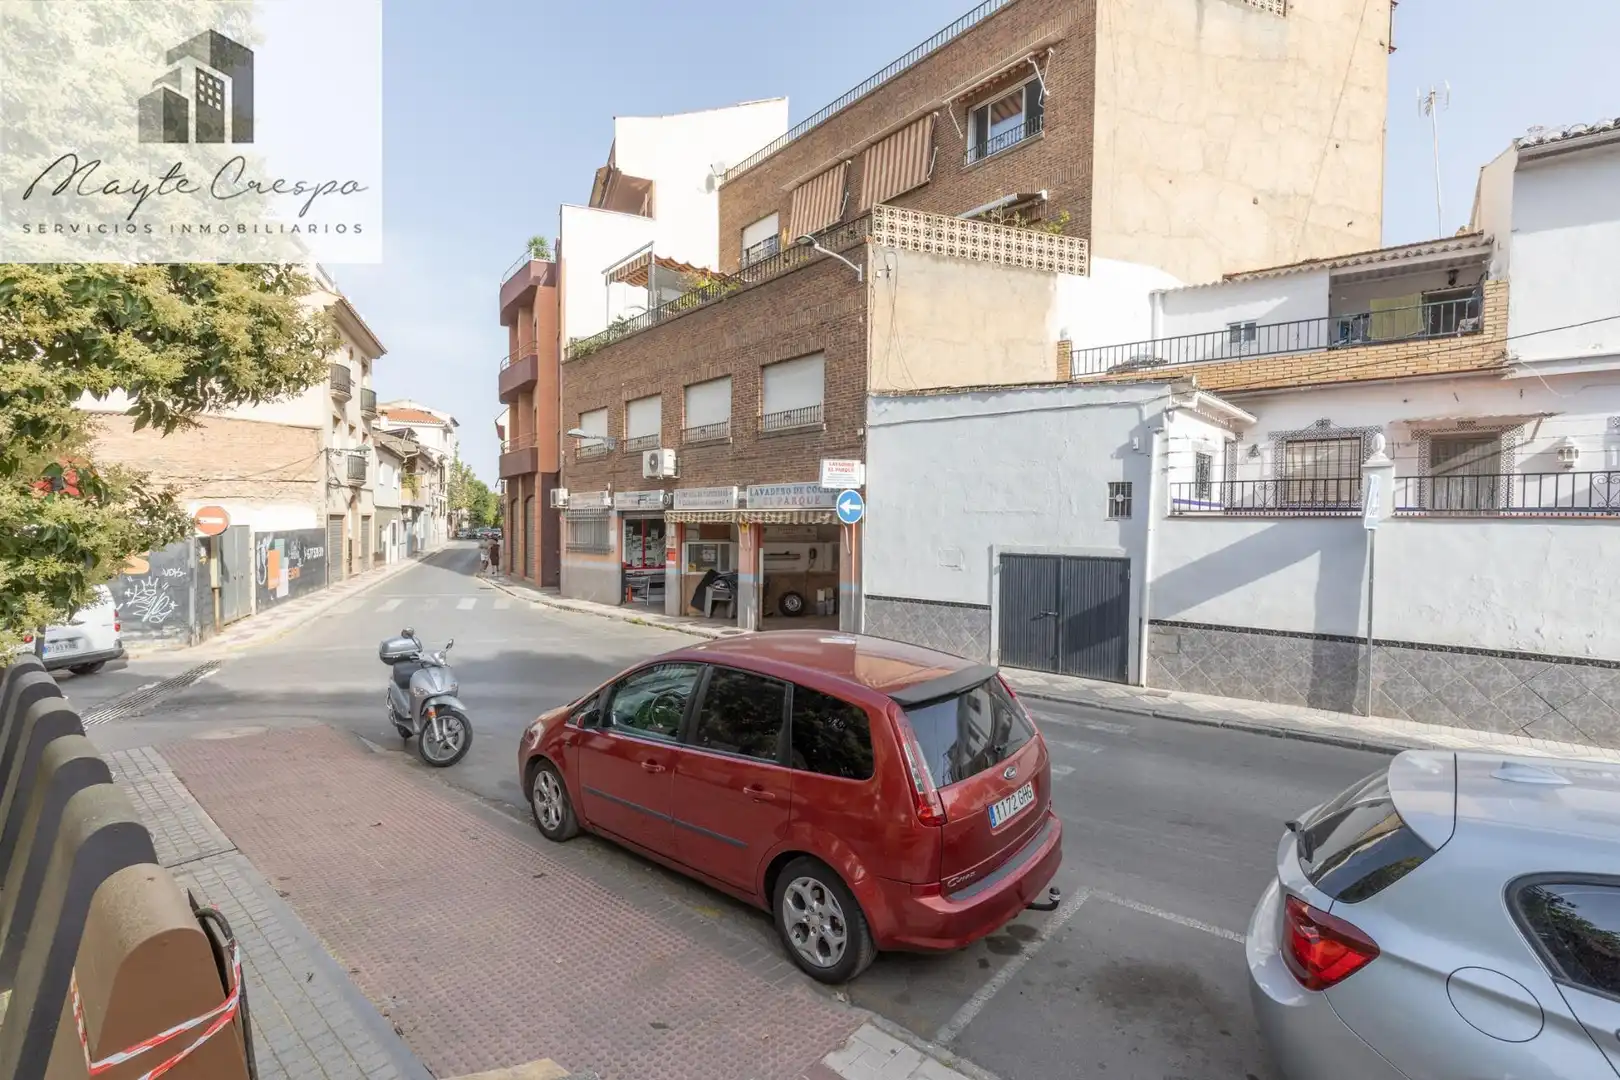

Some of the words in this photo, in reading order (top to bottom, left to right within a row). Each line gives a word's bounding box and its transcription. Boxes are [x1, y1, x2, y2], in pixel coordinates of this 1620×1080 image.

[749, 487, 791, 497] LAVADERO
[778, 494, 822, 506] PARQUE
[995, 795, 1018, 820] 1172
[1017, 783, 1033, 806] GHG
